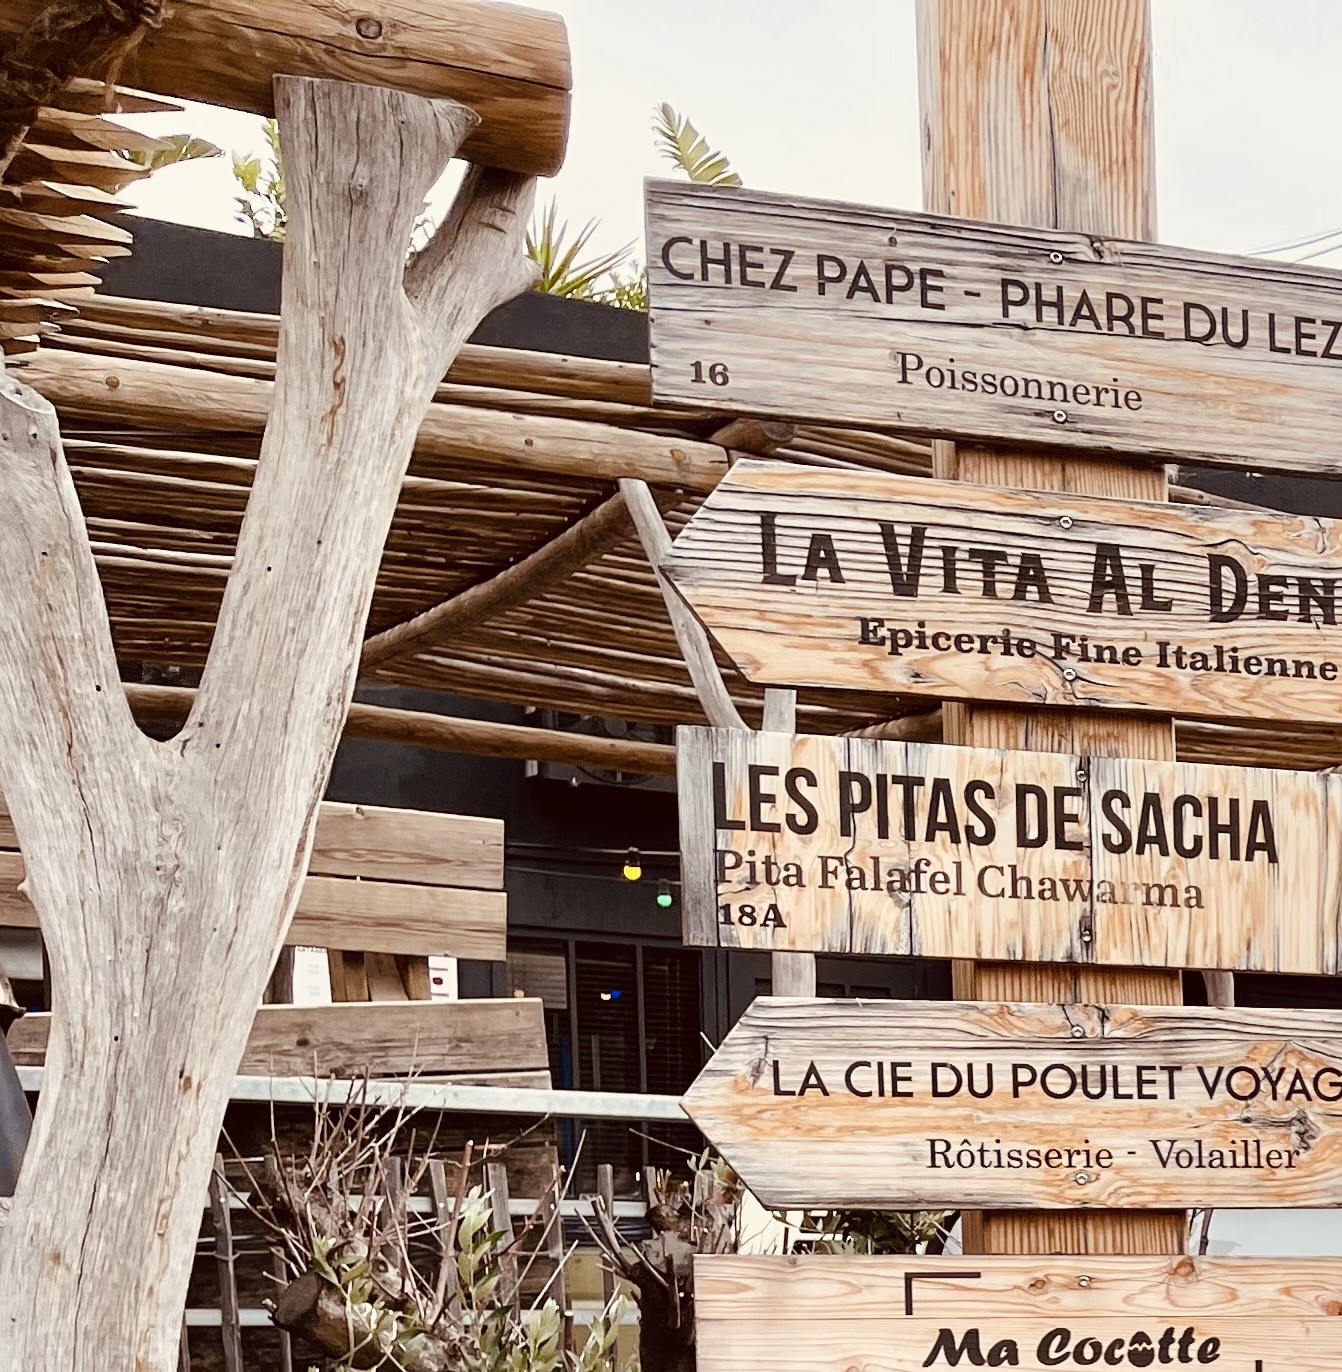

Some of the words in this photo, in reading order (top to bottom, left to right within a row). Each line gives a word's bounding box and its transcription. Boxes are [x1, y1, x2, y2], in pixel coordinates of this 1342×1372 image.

[662, 236, 797, 292] CHEZ
[818, 254, 946, 310] PAPE
[1001, 279, 1165, 340] PHARE
[1185, 303, 1249, 348] DU
[690, 360, 730, 387] 16
[896, 351, 1143, 412] Poissonnerie
[860, 616, 1038, 659] Epicerie
[1053, 633, 1142, 668] Fine
[1156, 640, 1338, 682] Italienne
[712, 762, 819, 835] LES
[840, 770, 997, 848] PITAS
[1016, 783, 1084, 852] DE
[1101, 788, 1279, 863] SACHA
[714, 849, 807, 888] Pita
[818, 855, 967, 897] Falafel
[718, 903, 787, 928] 18A
[772, 1060, 829, 1098] LA
[845, 1060, 914, 1099] CIE
[933, 1061, 995, 1100] DU
[1012, 1062, 1181, 1101] POULET
[926, 1137, 1114, 1170] Rôtisserie
[1150, 1137, 1300, 1171] Volailler
[922, 1328, 1020, 1368] Ma
